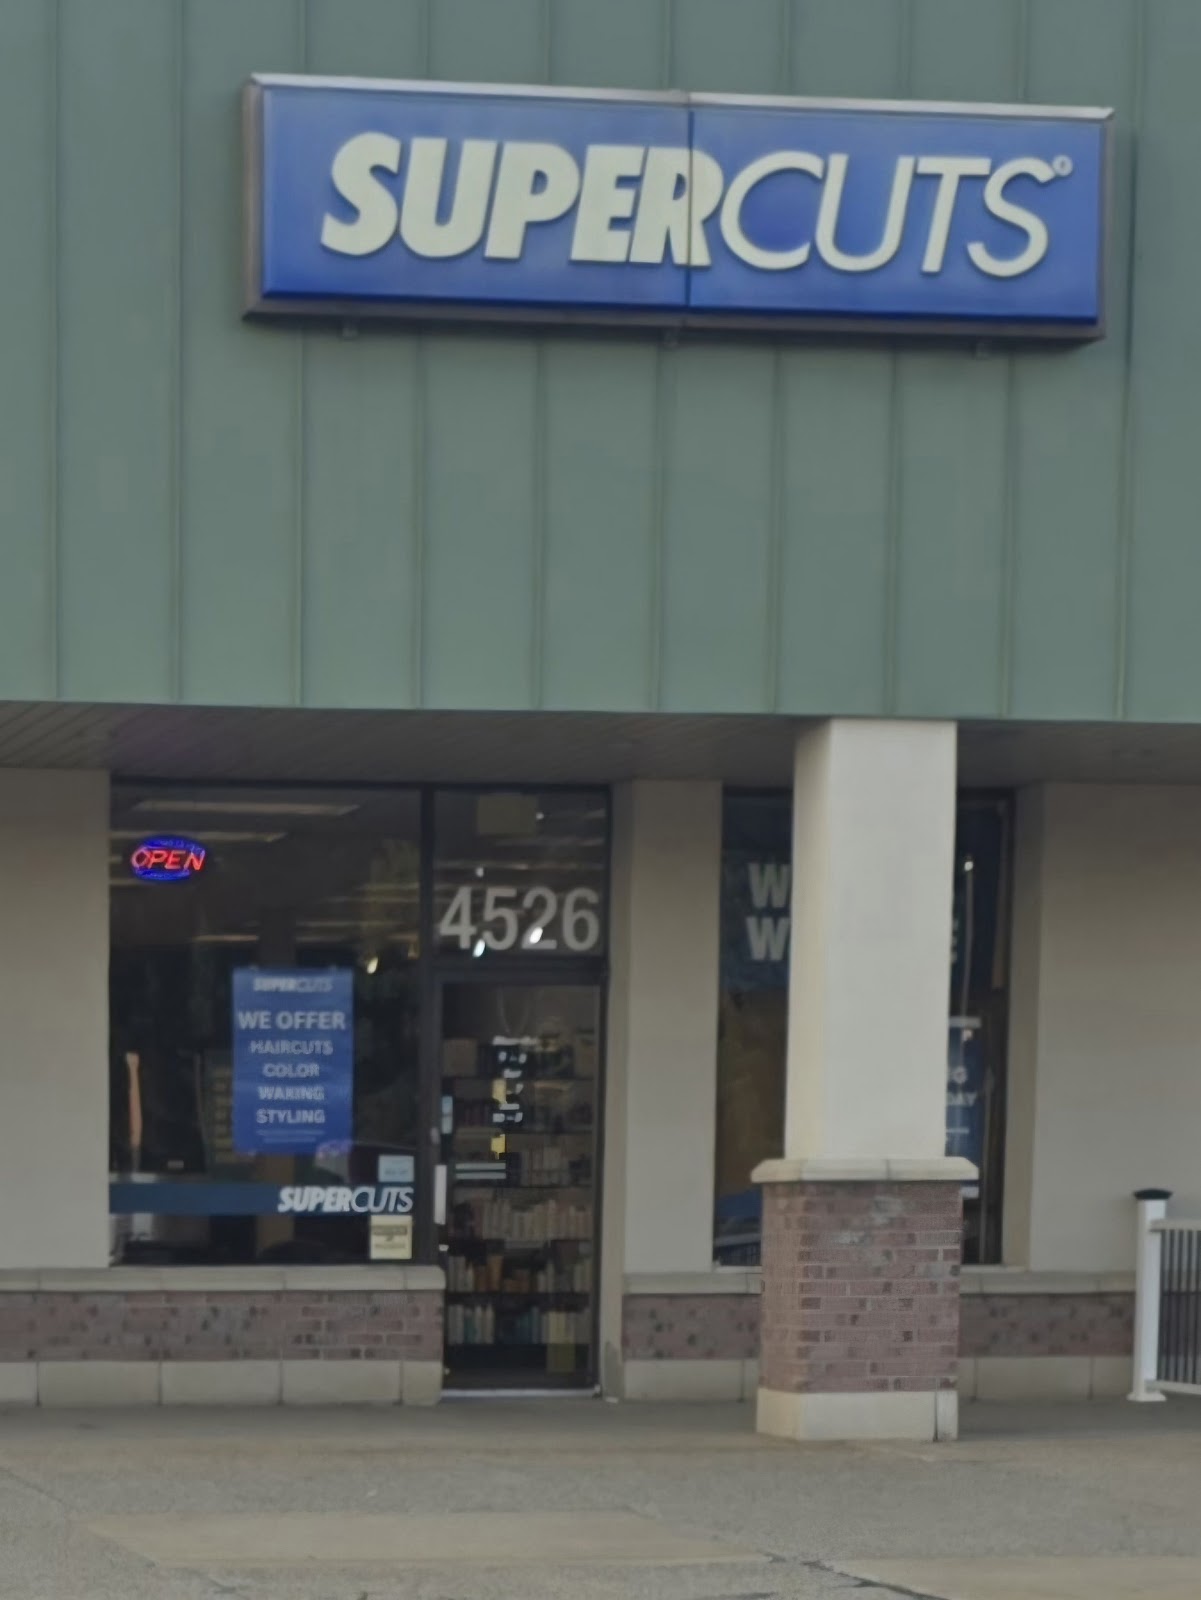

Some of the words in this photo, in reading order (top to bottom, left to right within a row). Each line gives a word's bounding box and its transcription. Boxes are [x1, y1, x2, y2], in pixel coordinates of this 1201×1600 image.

[321, 131, 1051, 279] SUPERCUTS
[131, 847, 206, 871] OPEN
[439, 885, 600, 950] 4526
[238, 1011, 272, 1031] WE
[276, 1011, 346, 1031] OFFER
[250, 1039, 334, 1055] HAIRCUTS
[263, 1063, 320, 1078] COLOR
[256, 1108, 326, 1124] STYLING
[277, 1186, 415, 1213] SUPERCUTS
